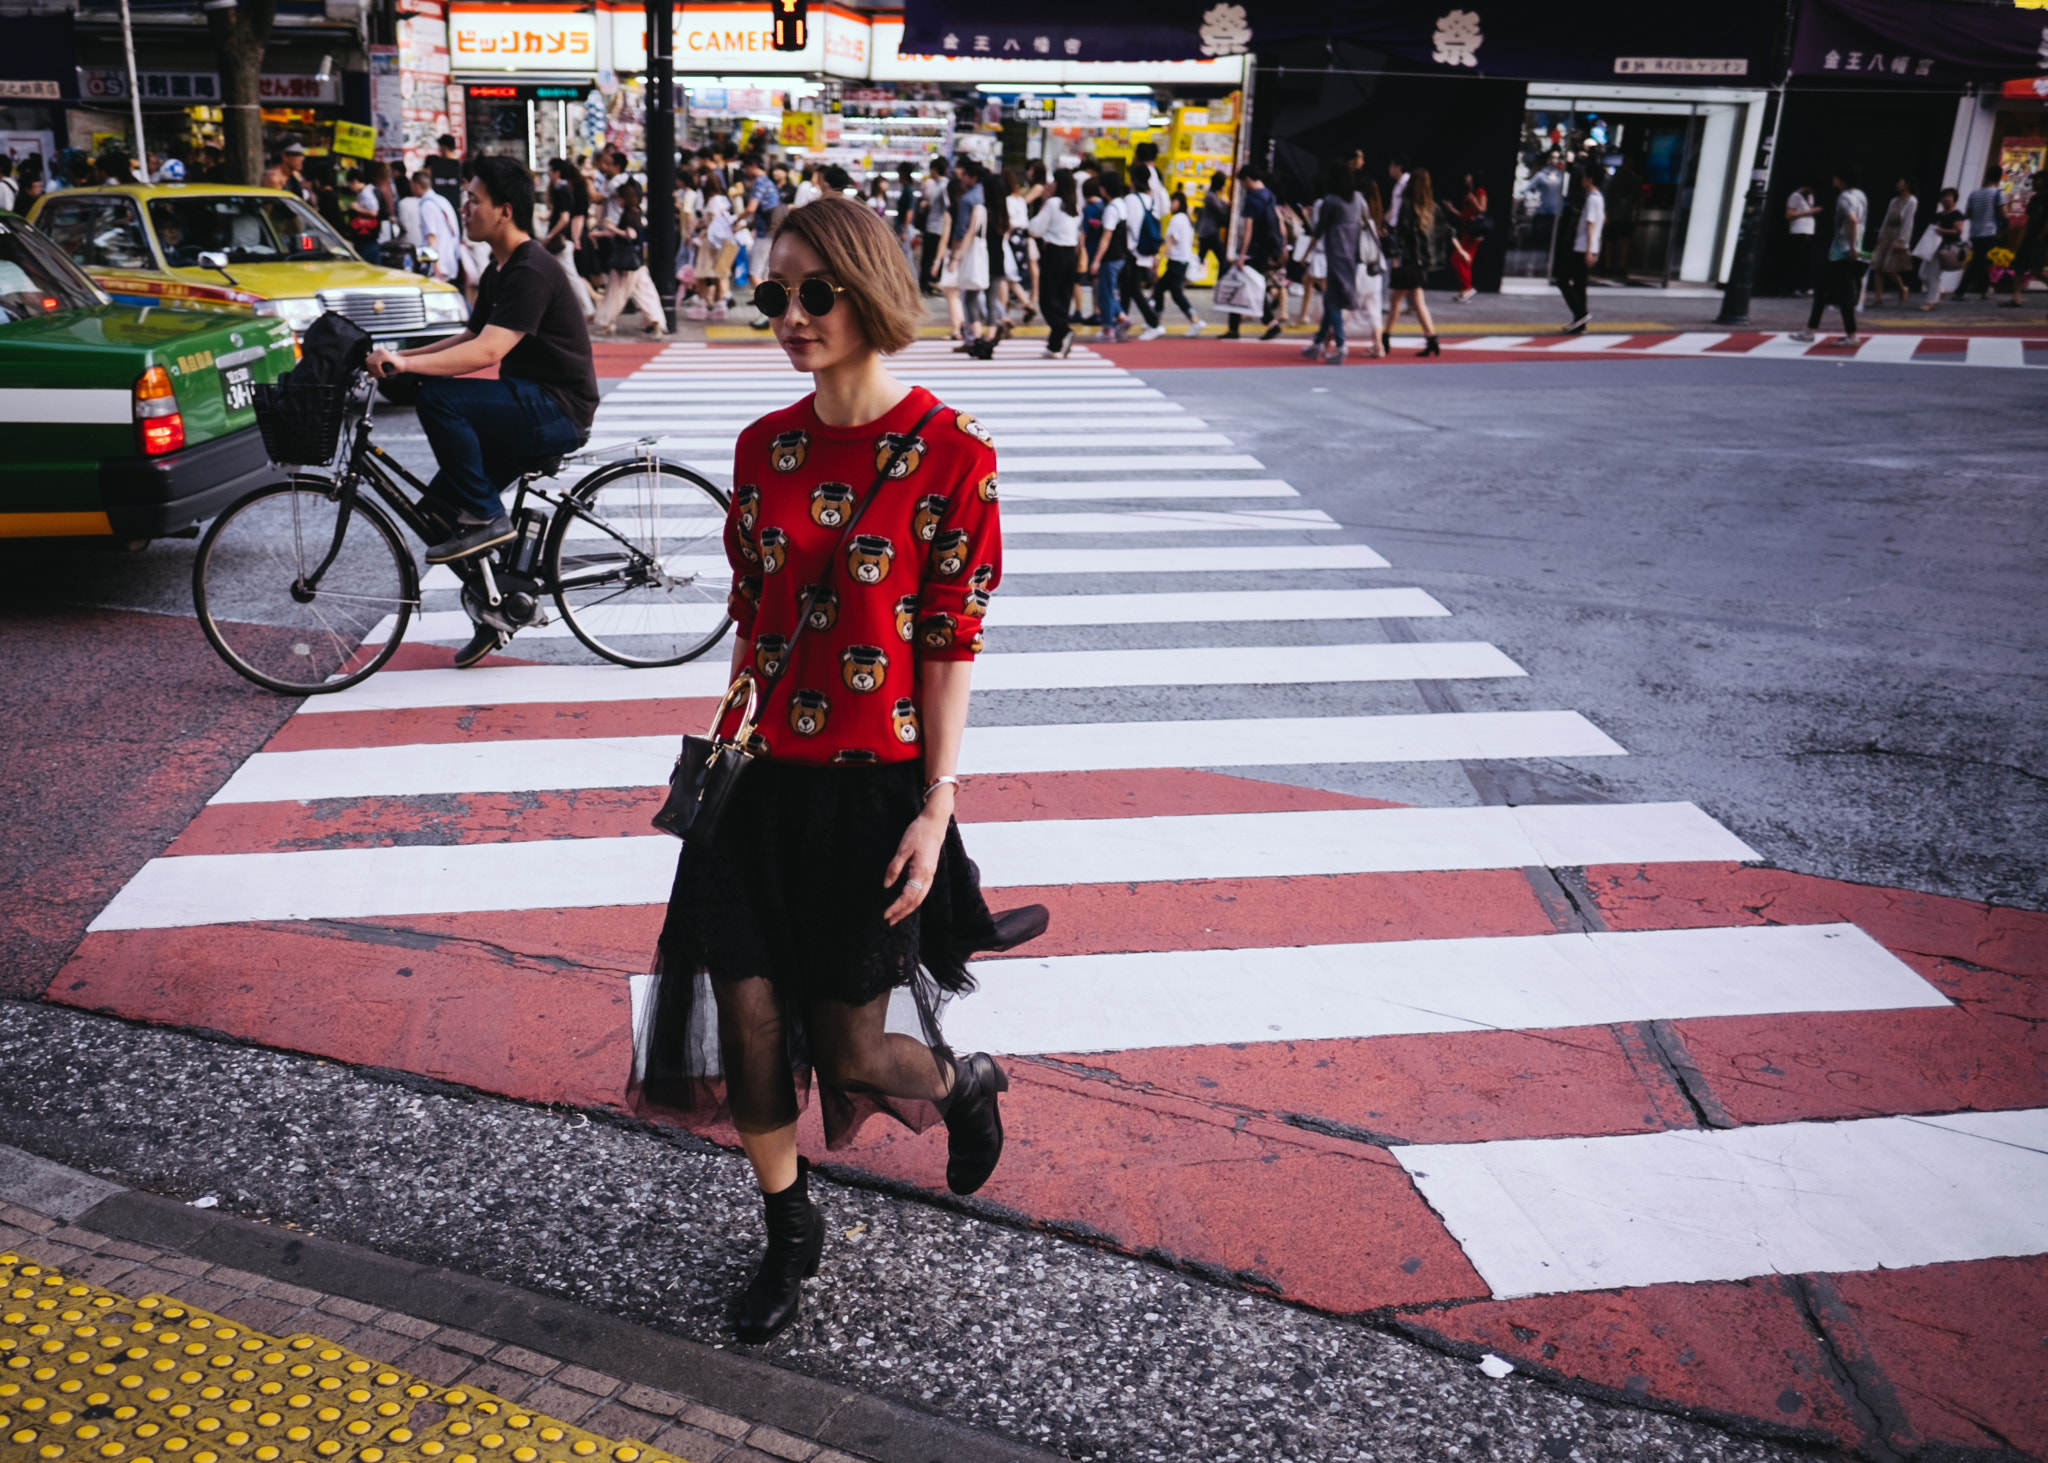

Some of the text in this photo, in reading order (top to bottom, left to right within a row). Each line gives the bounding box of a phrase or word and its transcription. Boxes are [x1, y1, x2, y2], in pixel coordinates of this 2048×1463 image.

[457, 29, 589, 54] ビックカメラ
[688, 30, 776, 51] CAMER
[1432, 9, 1484, 68] 祭
